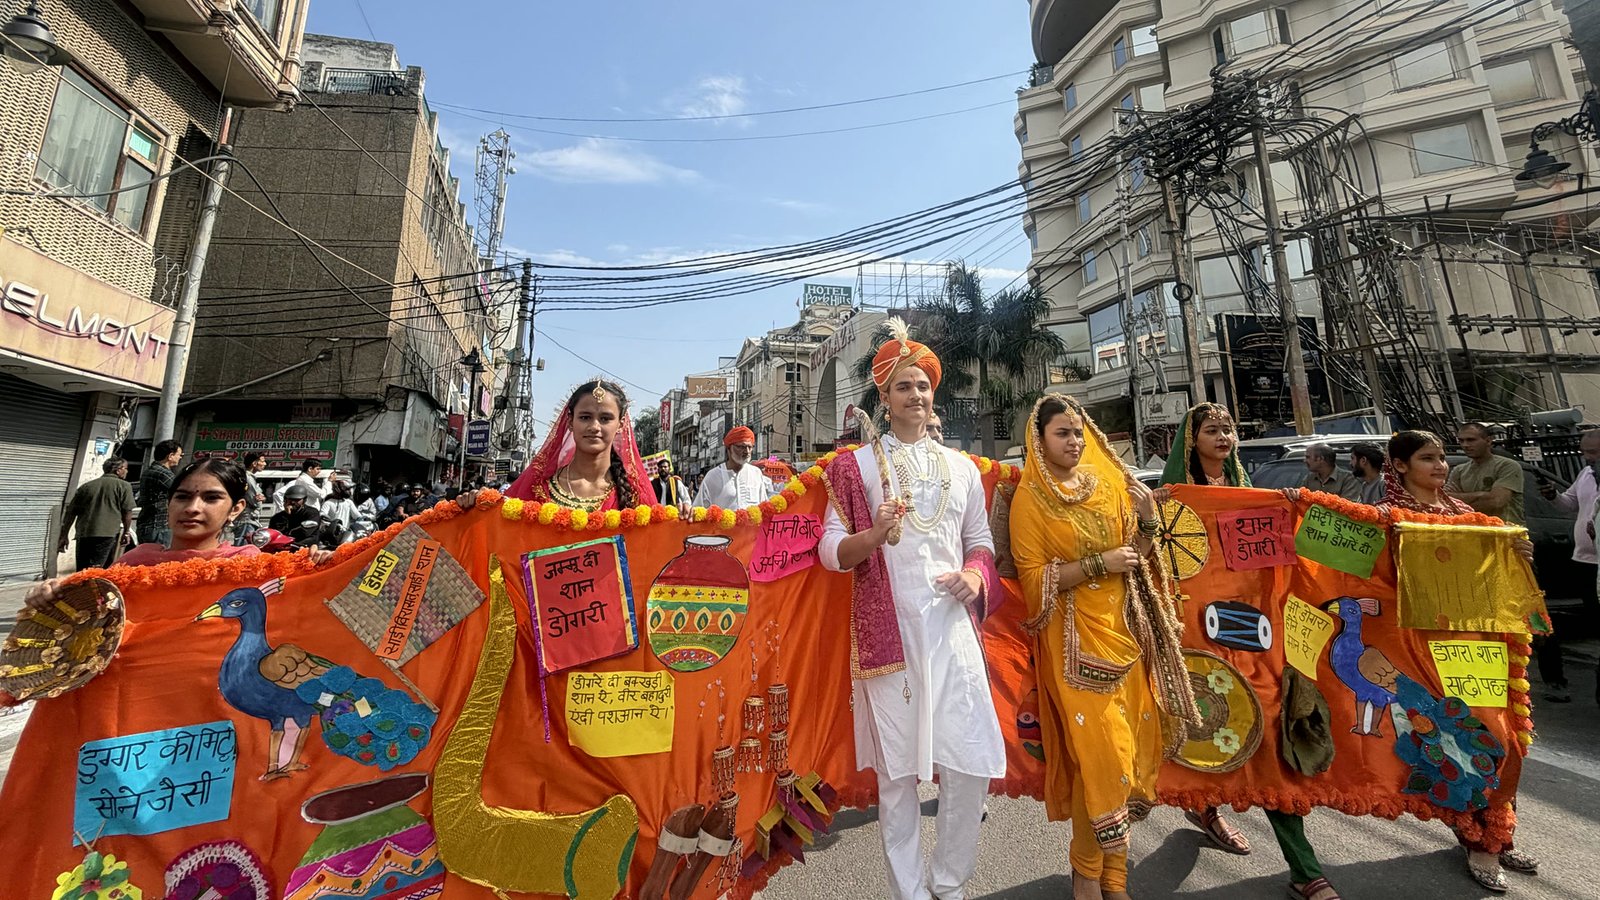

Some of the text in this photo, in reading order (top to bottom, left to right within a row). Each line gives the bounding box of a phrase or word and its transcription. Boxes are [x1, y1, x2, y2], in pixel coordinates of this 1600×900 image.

[807, 285, 849, 296] HOTEL
[830, 294, 851, 305] Hills
[0, 280, 168, 358] ELMONT
[212, 428, 336, 441] SHAH MULTI SPECIALITY
[230, 441, 316, 449] DOCTORS AVAILABLE
[1235, 516, 1274, 536] शान
[1305, 526, 1329, 543] शान
[416, 544, 434, 570] शान
[1238, 537, 1276, 560] डोगरी
[362, 551, 395, 590] डोगरी
[543, 550, 601, 580] जम्मू दी
[560, 578, 594, 599] शान
[547, 601, 608, 638] डोगरी
[608, 674, 622, 687] दी
[571, 693, 594, 705] शान
[618, 688, 640, 702] वीर
[160, 731, 198, 765] की
[89, 785, 155, 819] सोने
